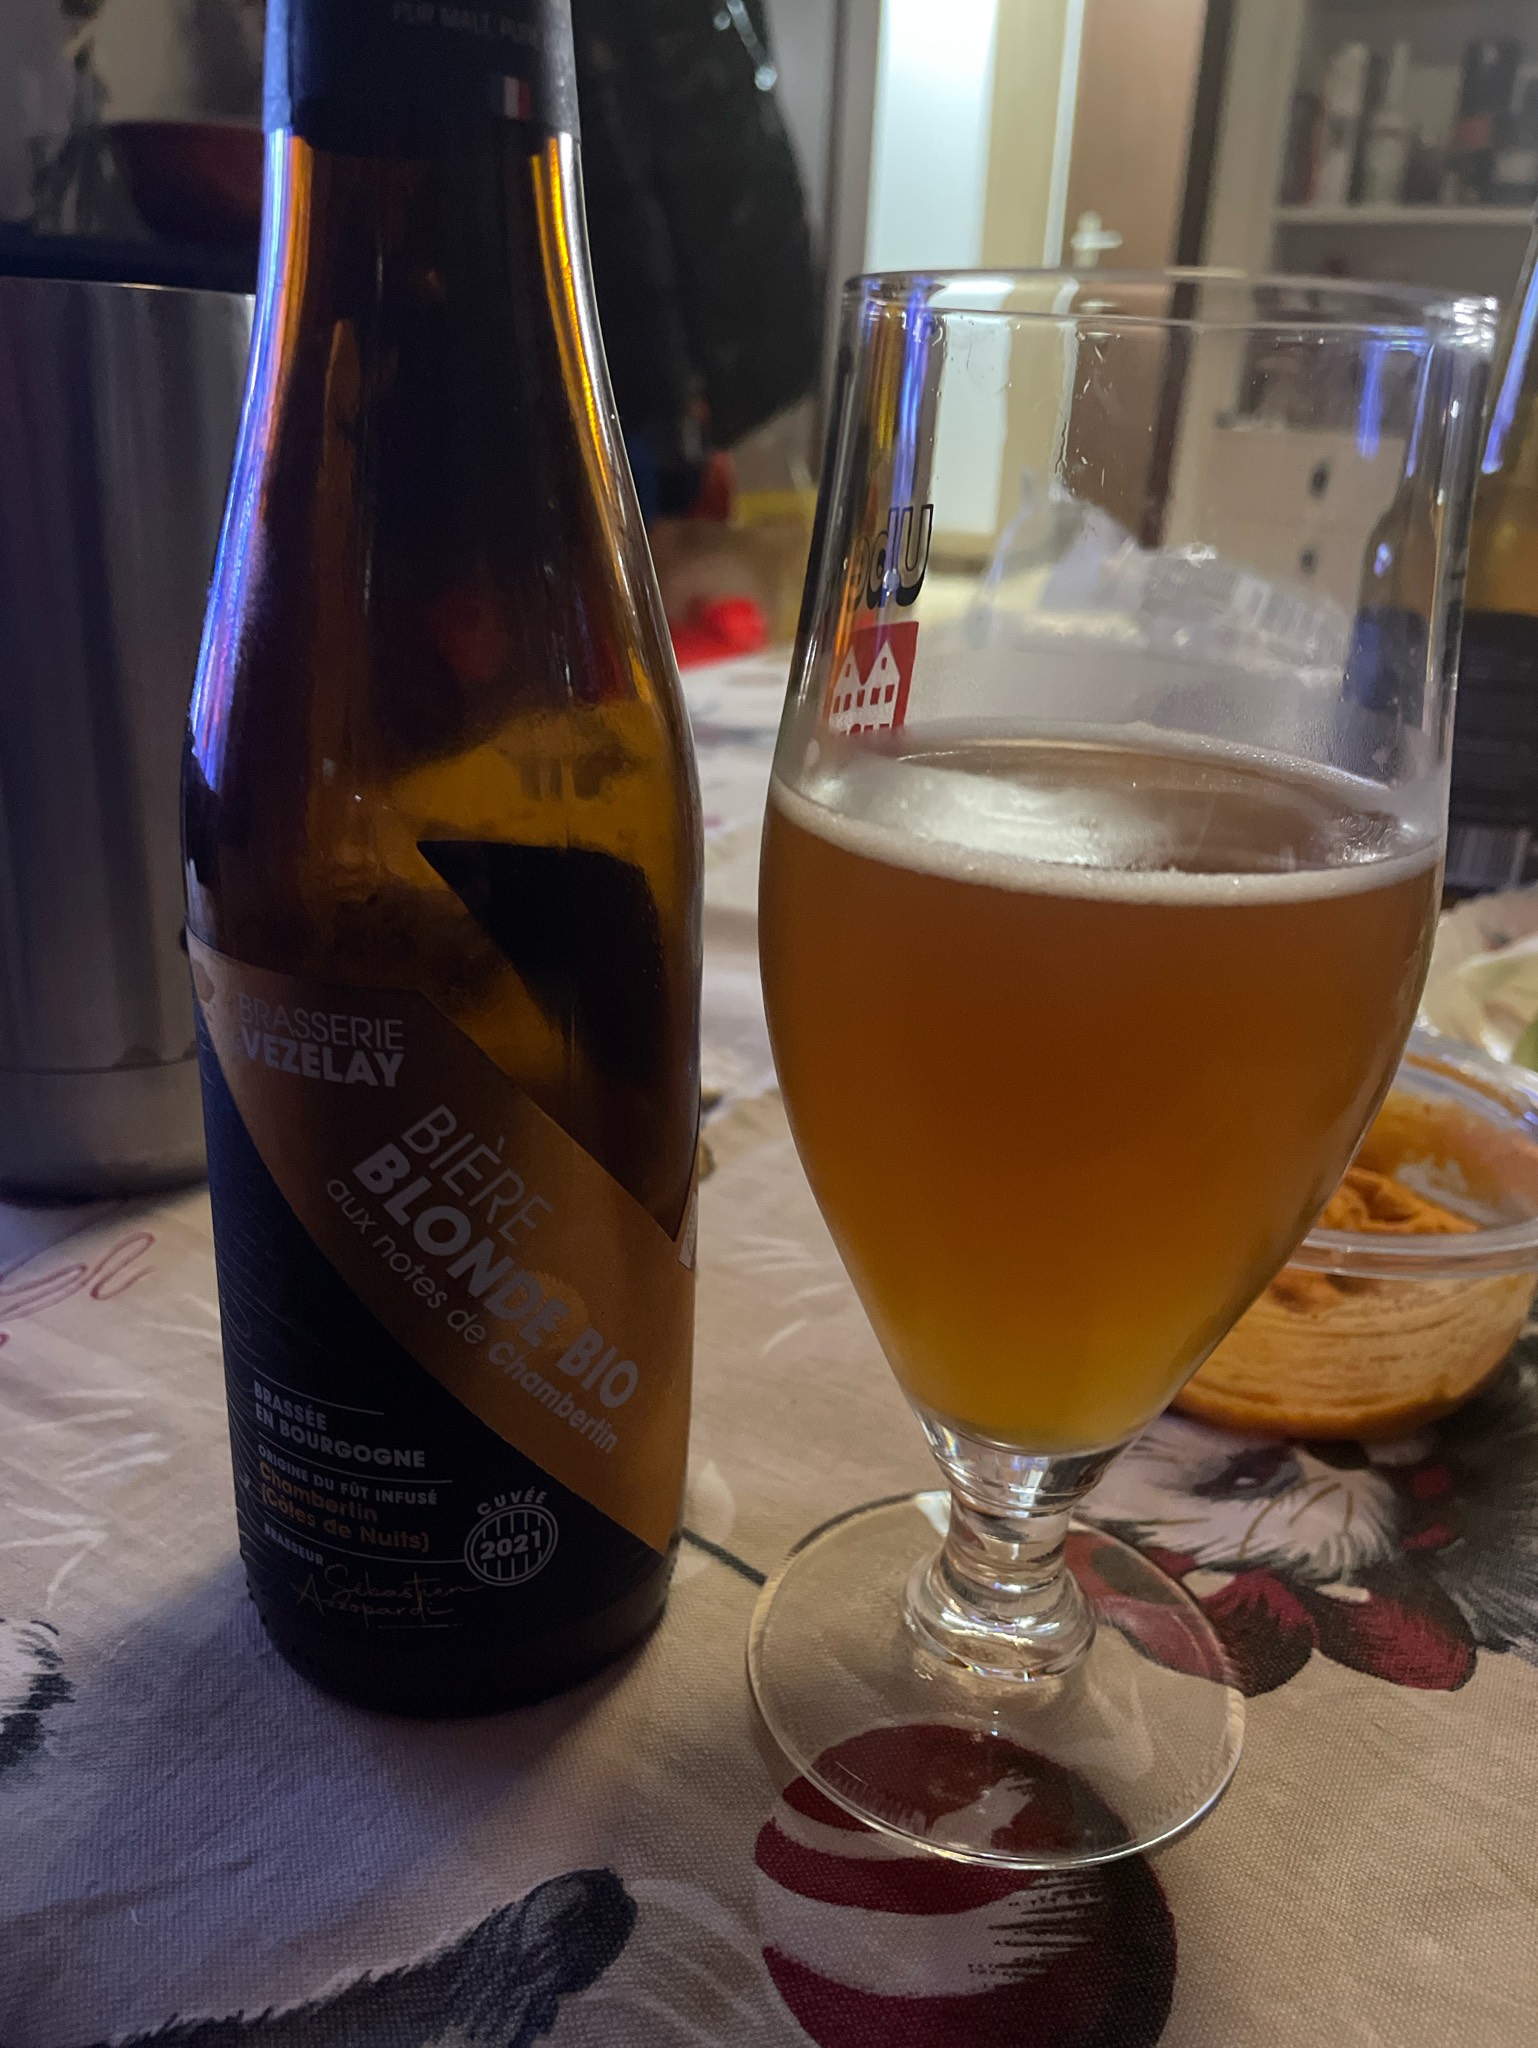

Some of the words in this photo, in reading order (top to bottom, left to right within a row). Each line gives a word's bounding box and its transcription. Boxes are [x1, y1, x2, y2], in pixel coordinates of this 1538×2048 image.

[238, 991, 405, 1051] BRASSERIE
[240, 1024, 404, 1089] VEZELAY
[401, 1105, 554, 1247] BIÈRE
[326, 1179, 378, 1236] aux
[371, 1234, 449, 1309] notes
[446, 1308, 487, 1344] de
[352, 1142, 572, 1348] BLONDE
[556, 1326, 639, 1409] BIO
[253, 1379, 328, 1432] BRASSÉE
[255, 1404, 274, 1430] EN
[279, 1417, 426, 1469] BOURGOGNE
[258, 1443, 309, 1485] ORIGINE
[313, 1472, 335, 1491] DU
[340, 1479, 369, 1502] FÛT
[375, 1487, 438, 1506] INFUSÉ
[477, 1486, 548, 1516] CUVÉE
[263, 1521, 325, 1567] BRASSEUR
[322, 1512, 352, 1540] de
[359, 1524, 430, 1553] Nuits)
[480, 1529, 541, 1560] 2021
